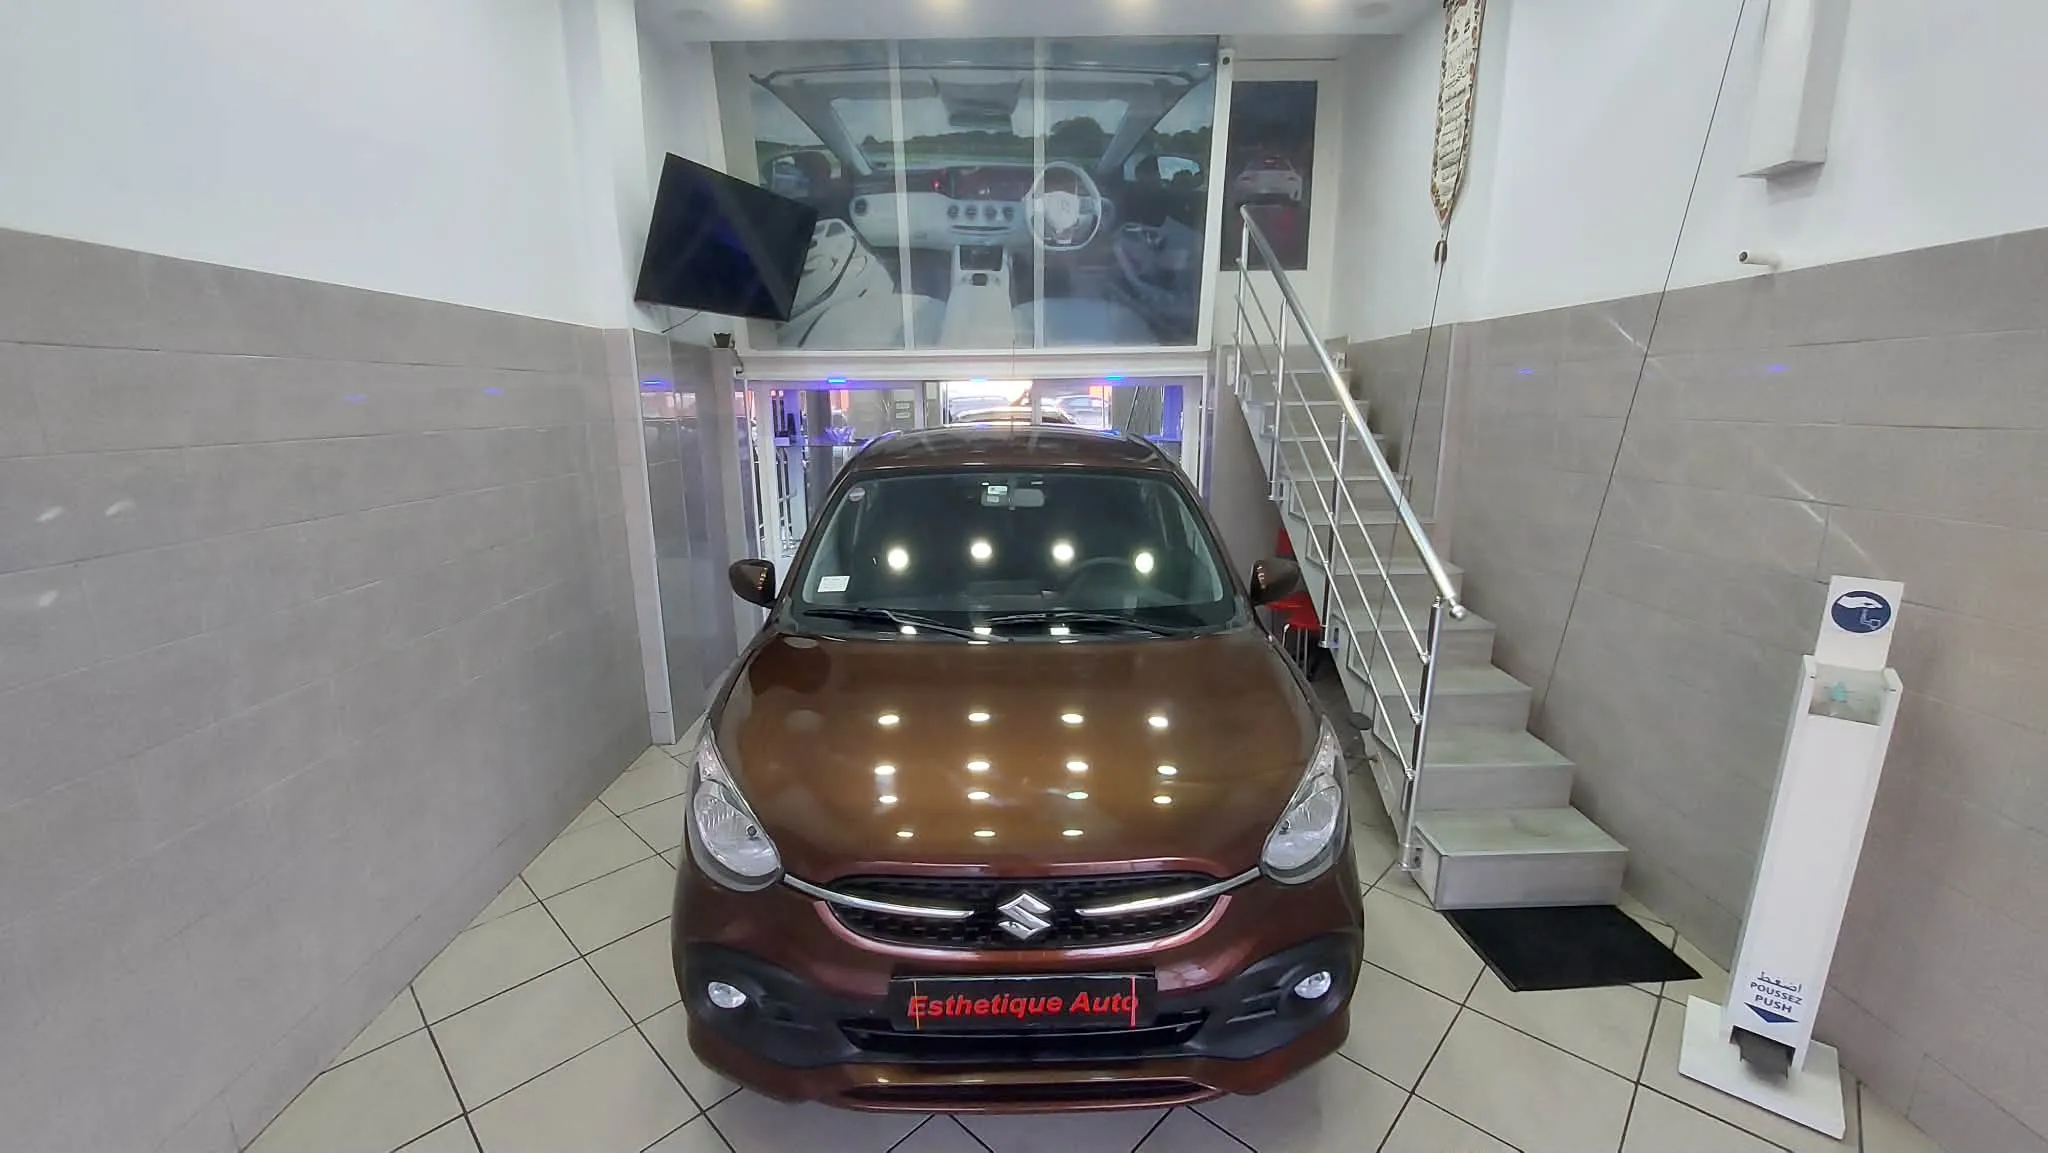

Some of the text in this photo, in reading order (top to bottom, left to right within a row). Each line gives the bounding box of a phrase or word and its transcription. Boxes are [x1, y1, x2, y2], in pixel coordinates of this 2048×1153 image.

[907, 991, 1139, 1019] Esthetique Auto
[1750, 982, 1803, 1005] POUSSEZ
[1755, 995, 1792, 1013] PUSH
